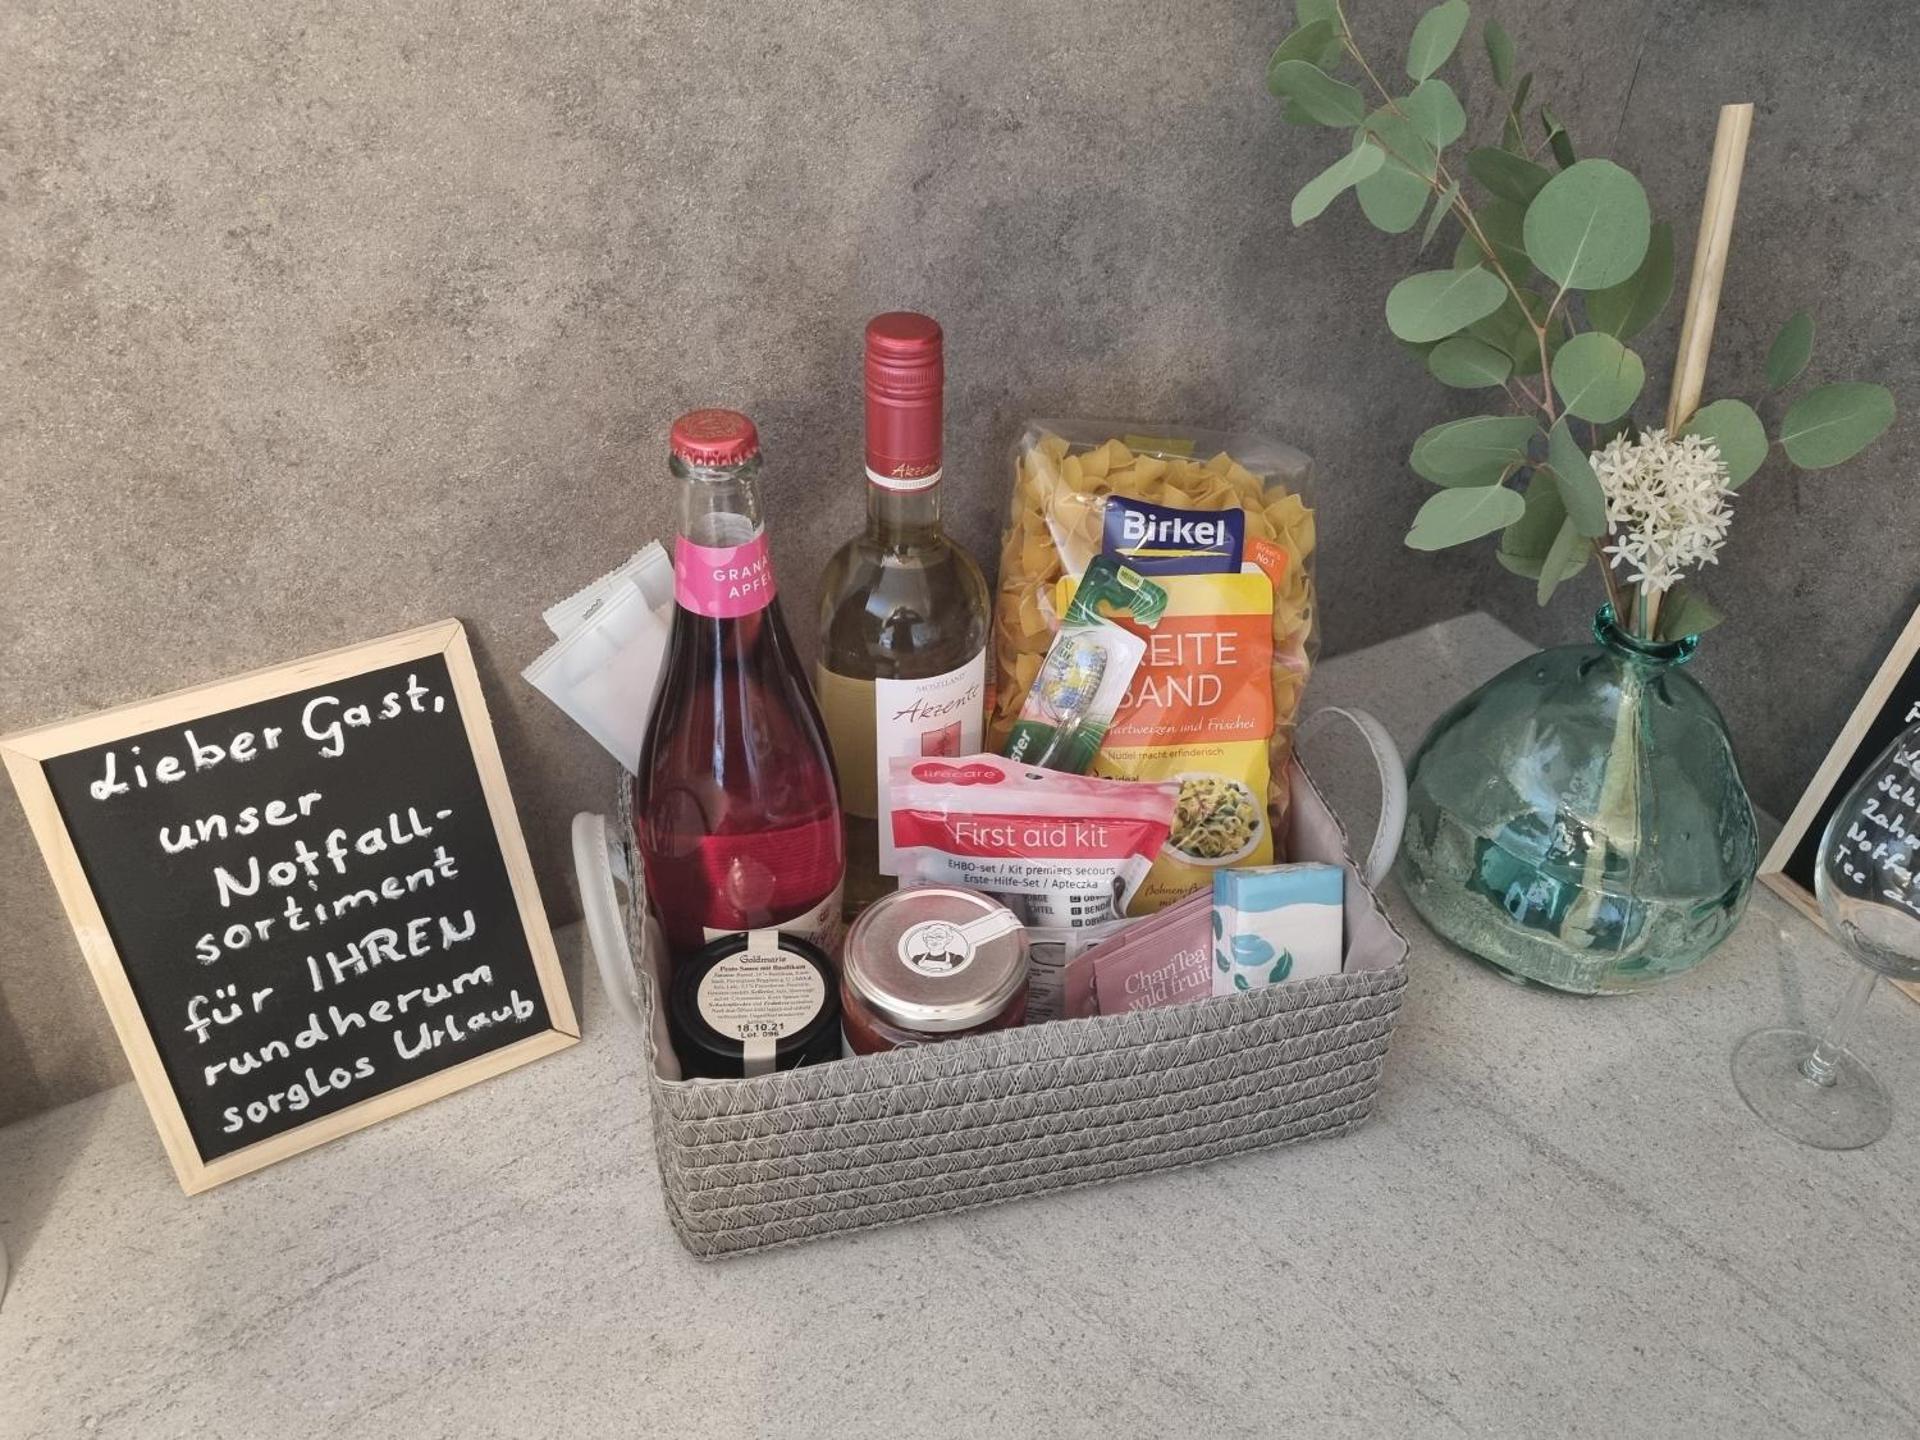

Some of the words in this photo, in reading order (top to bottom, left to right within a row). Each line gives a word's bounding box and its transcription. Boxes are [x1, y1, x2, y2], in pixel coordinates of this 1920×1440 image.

[1122, 510, 1226, 546] Birkel
[1141, 632, 1238, 667] EITE
[90, 727, 283, 800] Lieber
[301, 674, 445, 758] Gast,
[1181, 717, 1203, 732] und
[1207, 714, 1256, 732] Frischei
[1169, 747, 1225, 759] erfinderisch
[1878, 774, 1920, 813] Sek
[159, 790, 322, 854] unser
[954, 821, 1016, 847] First
[1022, 823, 1067, 848] aid
[1075, 824, 1108, 848] kit
[214, 808, 453, 907] Notfall-
[948, 858, 997, 874] EHBO-set
[1008, 864, 1023, 875] Kit
[1026, 864, 1073, 877] premiers
[1075, 866, 1116, 876] secours
[1834, 844, 1866, 884] Tee
[963, 873, 1040, 888] Erste-Hilfe-Set
[1051, 878, 1098, 890] Apteczka
[195, 846, 459, 965] sortiment
[184, 984, 274, 1043] für
[306, 910, 476, 993] IHREN
[1124, 948, 1208, 994] ChariTea
[1128, 981, 1168, 1011] wild
[1171, 964, 1213, 995] fruit
[204, 965, 493, 1087] rundherum
[737, 1022, 785, 1033] 18.10.21
[223, 1057, 376, 1133] sorglos
[394, 989, 535, 1060] Urlaub
